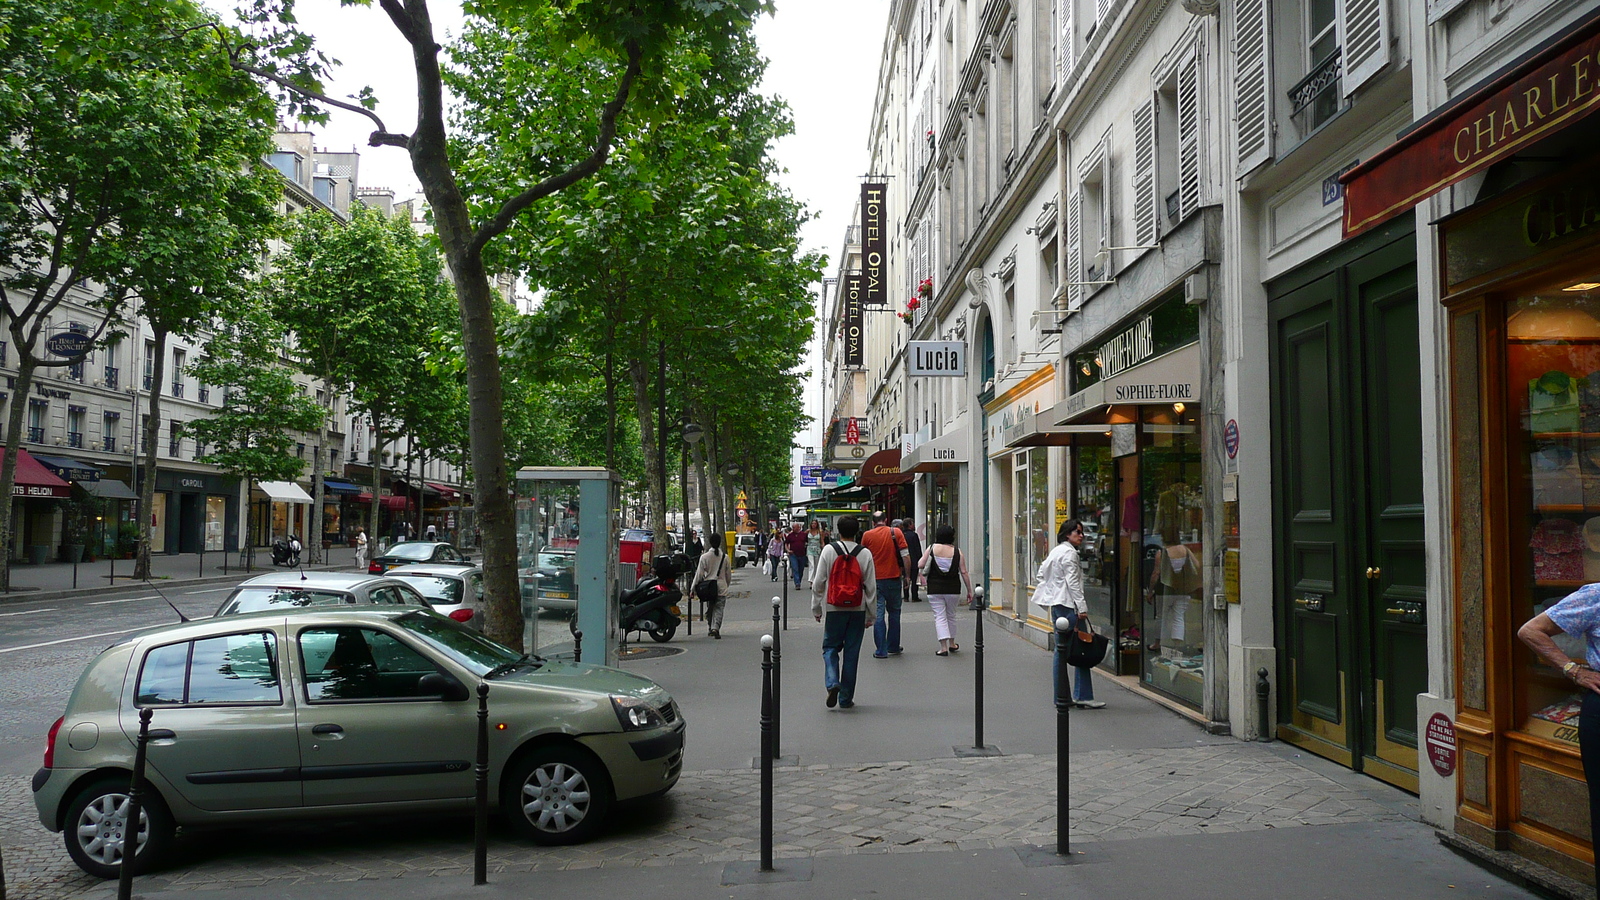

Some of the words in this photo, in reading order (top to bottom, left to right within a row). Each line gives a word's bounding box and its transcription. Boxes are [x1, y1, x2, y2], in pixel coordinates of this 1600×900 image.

[1453, 52, 1600, 164] CHARLE
[1325, 181, 1337, 203] 25
[867, 190, 881, 248] HOTEL
[867, 252, 881, 299] OPAL
[849, 280, 860, 322] HOTEL
[849, 326, 860, 361] OPAL
[1099, 315, 1153, 380] SOPHIE-FLORE
[916, 346, 958, 371] Lucia
[1116, 383, 1192, 400] SOPHIE-FLORE
[933, 448, 955, 459] Lucia
[182, 478, 203, 488] CAROLL
[1429, 730, 1454, 743] STATIONNER
[1444, 728, 1453, 736] PAS
[1434, 746, 1450, 757] SORTIE
